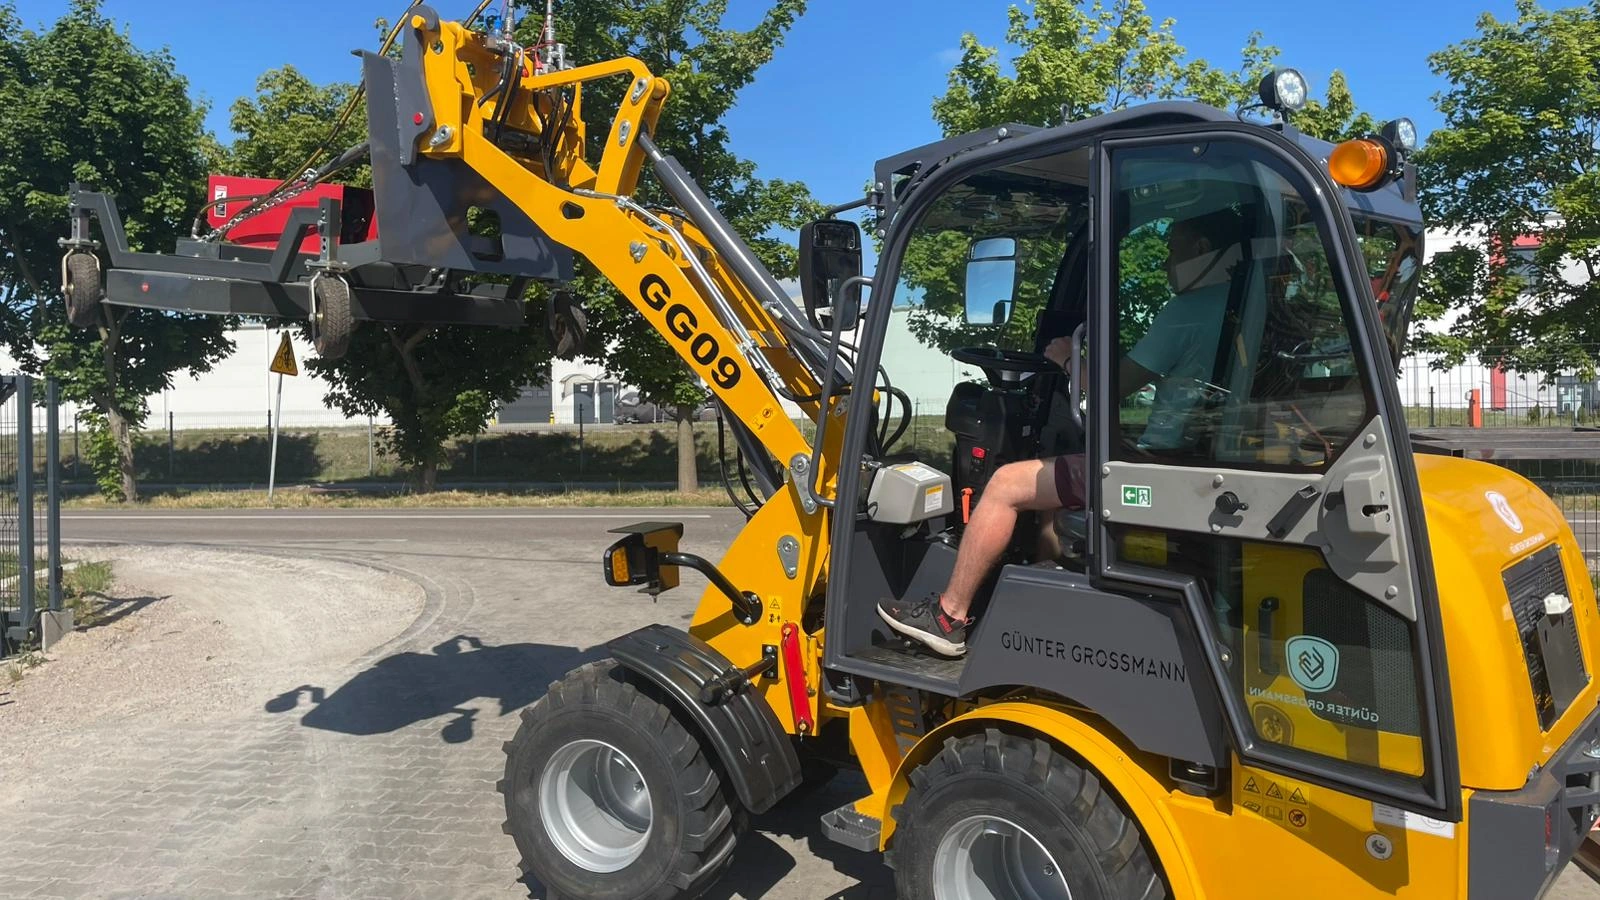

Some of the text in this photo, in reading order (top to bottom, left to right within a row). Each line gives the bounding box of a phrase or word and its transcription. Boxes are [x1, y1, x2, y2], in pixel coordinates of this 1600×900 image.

[639, 273, 741, 389] GG09
[1001, 631, 1186, 683] GÜNTER GROSSMANN
